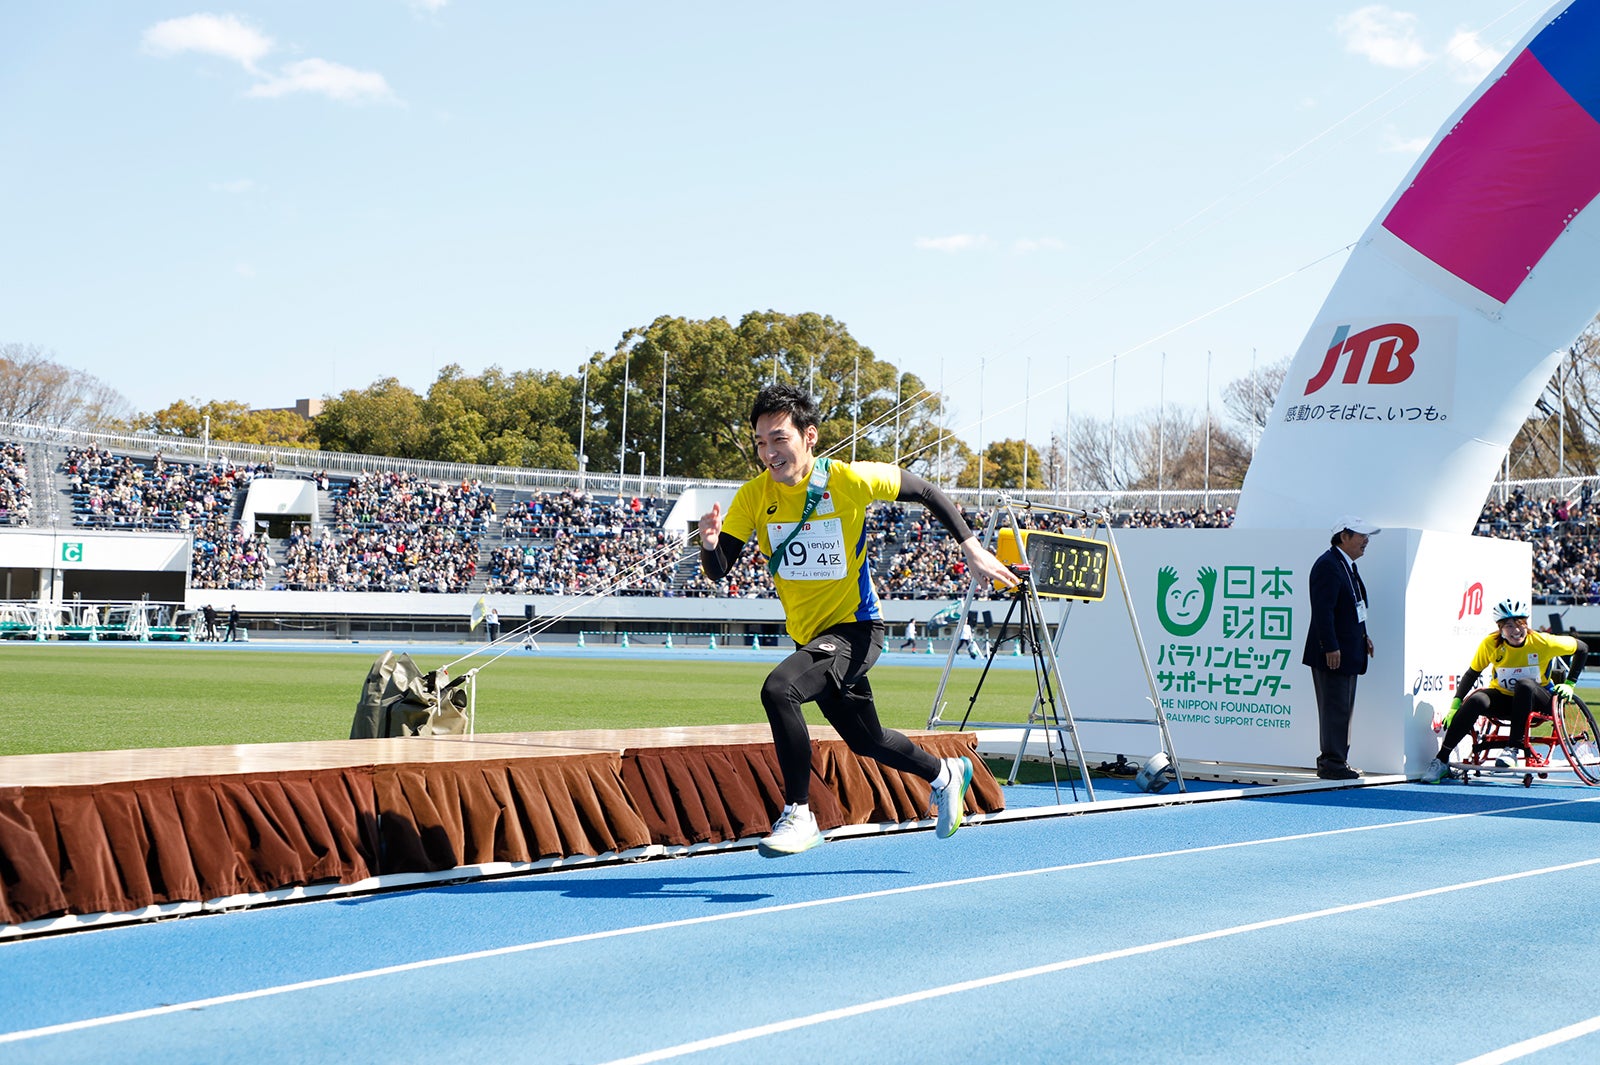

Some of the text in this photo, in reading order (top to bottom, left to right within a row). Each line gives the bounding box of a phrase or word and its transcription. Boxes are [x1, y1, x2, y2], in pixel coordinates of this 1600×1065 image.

[1304, 323, 1419, 396] JTB
[1284, 403, 1447, 422] 感動のそばに、いつも。
[65, 546, 81, 562] C
[1223, 565, 1293, 600] 日本
[1458, 581, 1484, 621] JTB
[1157, 643, 1292, 671] パラリンピック
[1156, 670, 1292, 697] サポートセンター
[1423, 674, 1443, 692] asics
[1177, 699, 1218, 711] NIPPON
[1220, 701, 1292, 716] FOUNDATION
[1214, 715, 1254, 727] SUPPORT
[1256, 718, 1291, 729] CENTER
